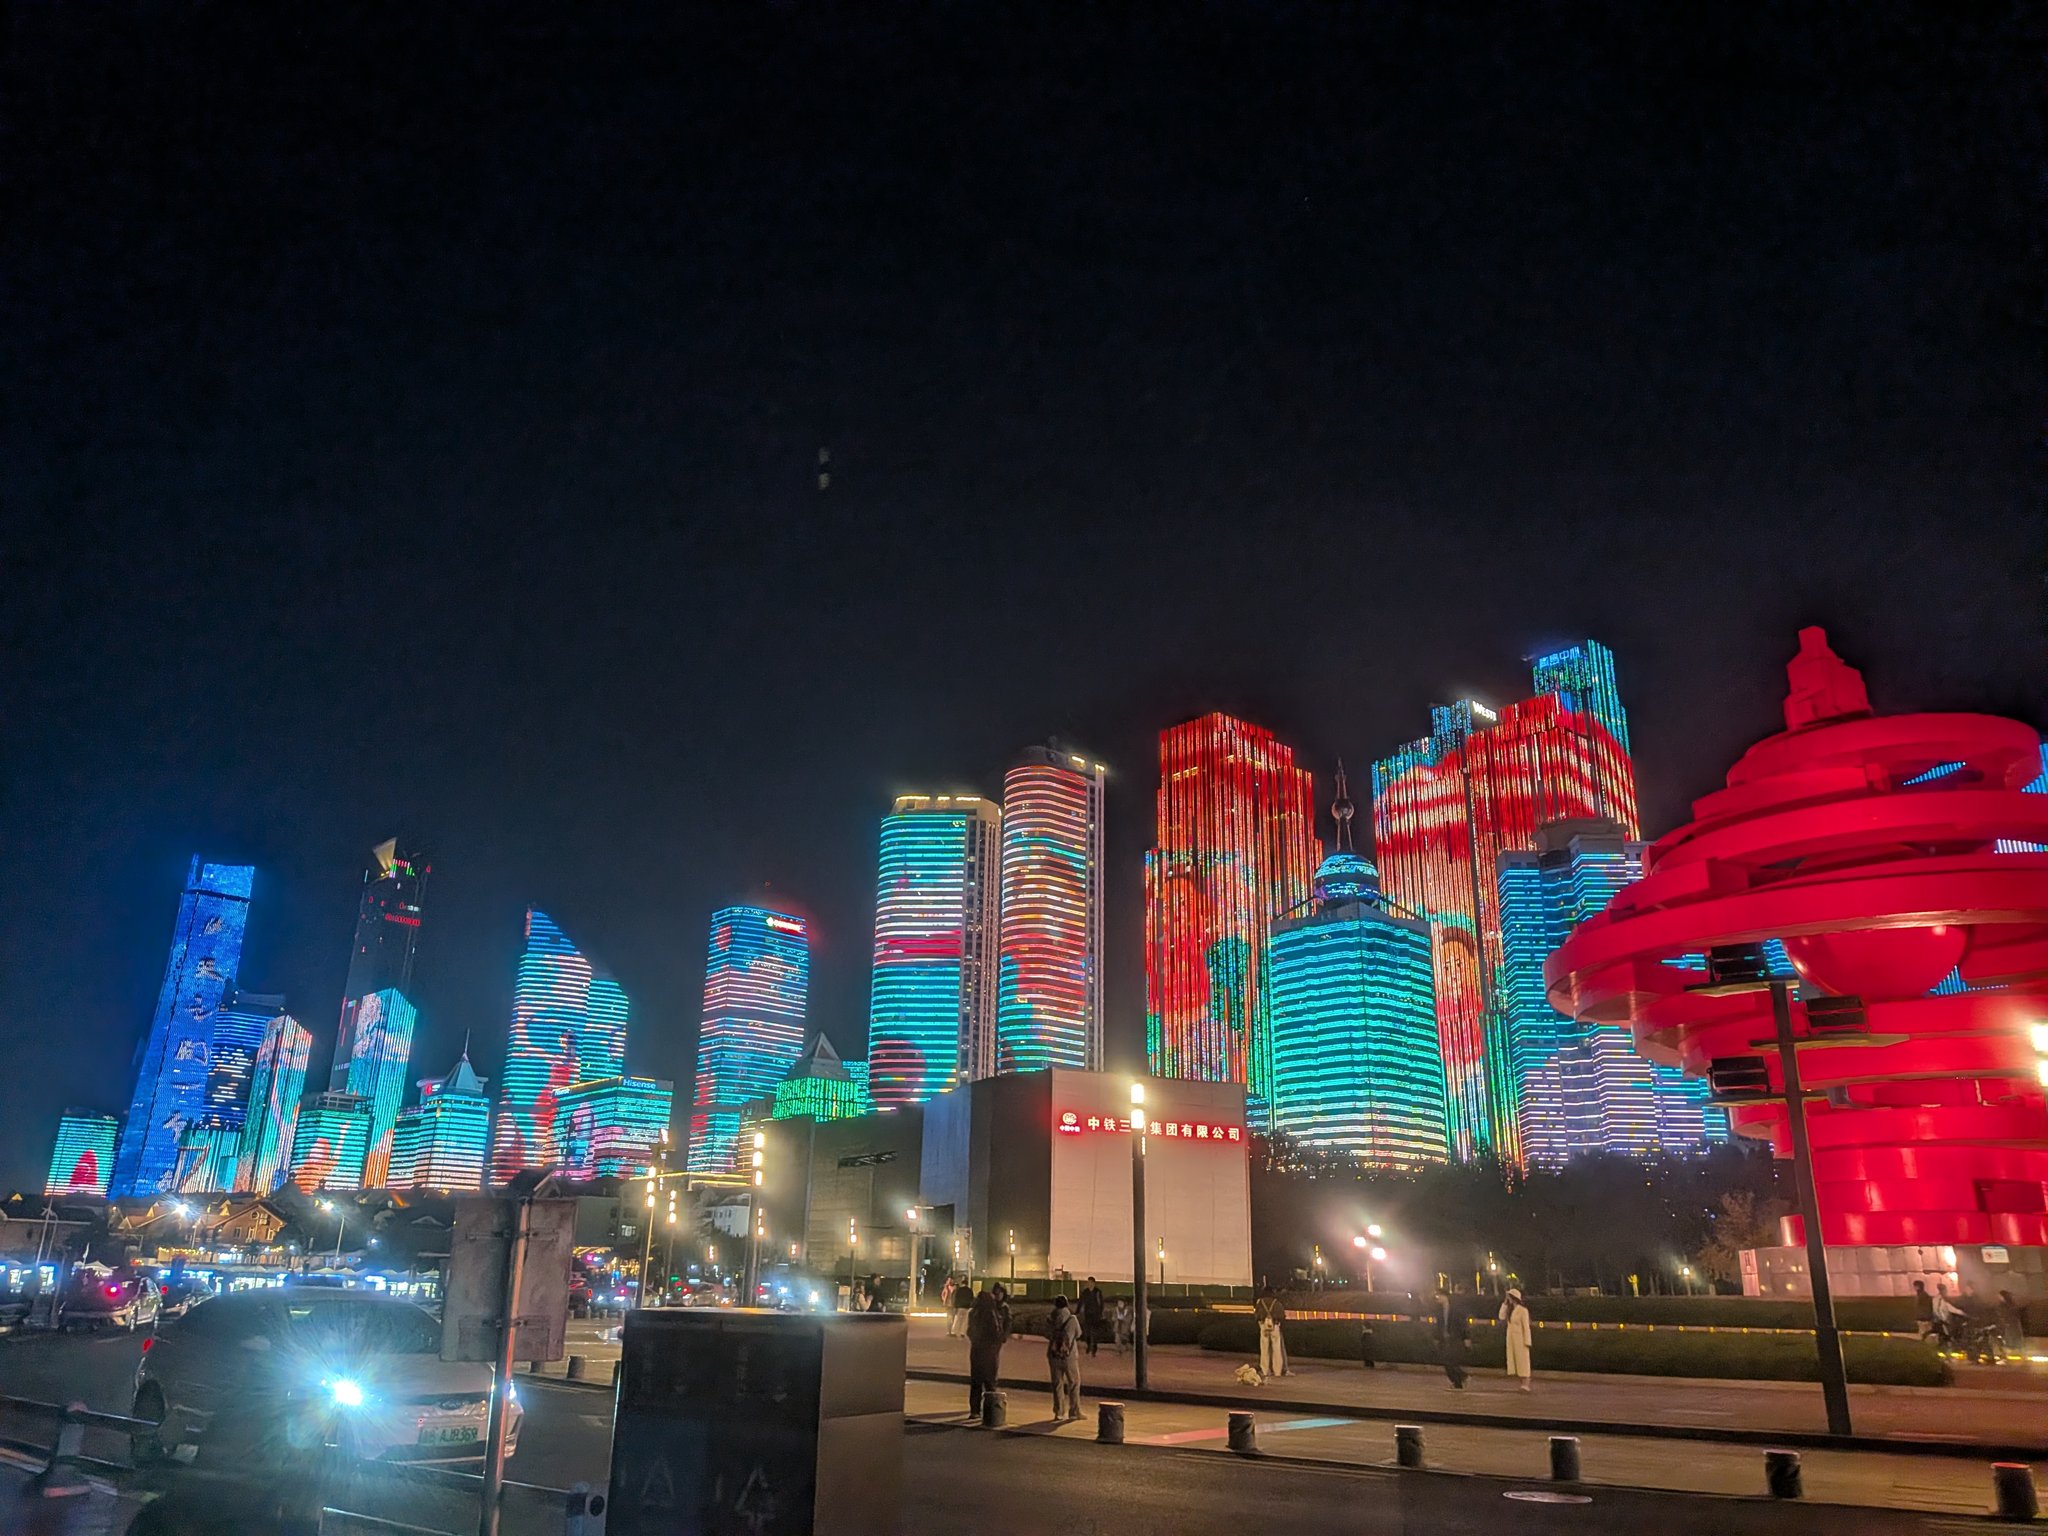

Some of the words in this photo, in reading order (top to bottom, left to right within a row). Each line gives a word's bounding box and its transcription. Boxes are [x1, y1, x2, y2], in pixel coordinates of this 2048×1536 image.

[623, 1079, 656, 1090] Hisense
[1087, 1116, 1240, 1141] 中铁三集团有限公司
